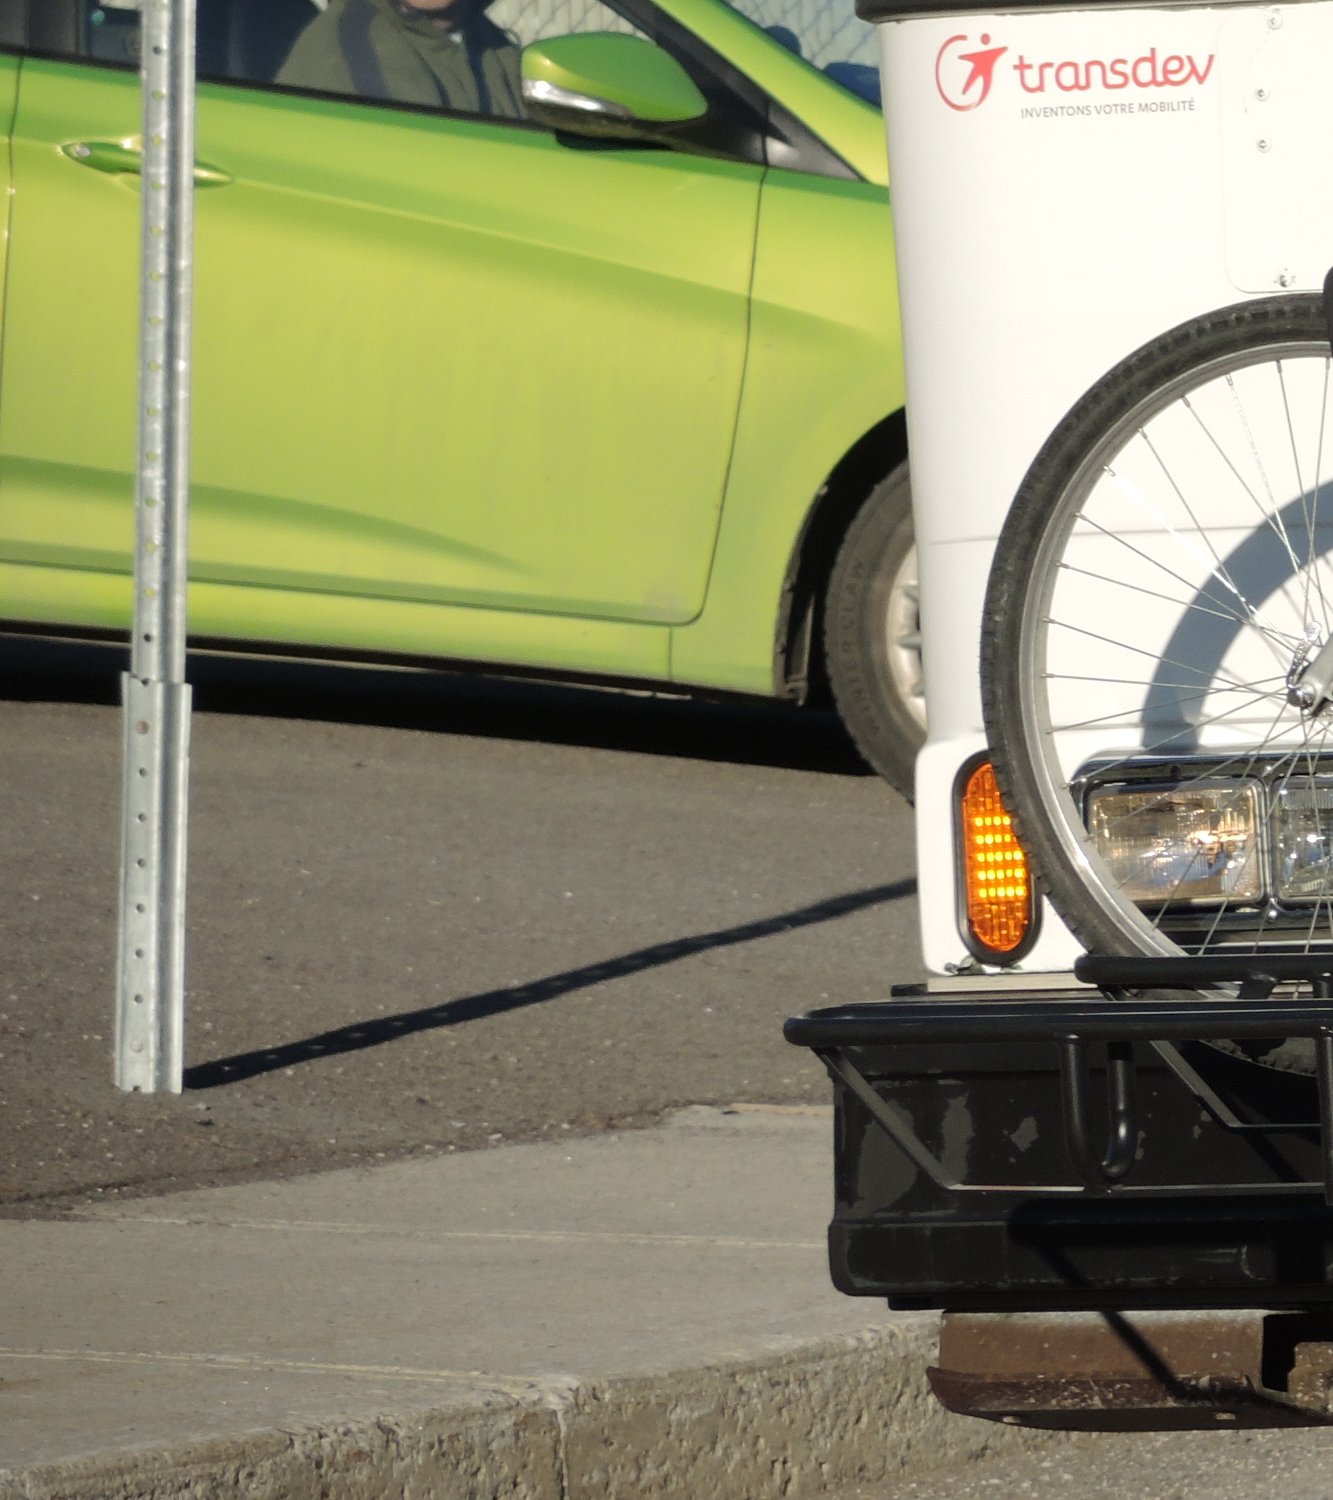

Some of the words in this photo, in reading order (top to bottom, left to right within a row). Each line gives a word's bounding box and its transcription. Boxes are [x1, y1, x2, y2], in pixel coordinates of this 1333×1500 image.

[1012, 46, 1215, 94] transdev
[1020, 103, 1092, 120] INVENTONS
[1094, 101, 1135, 116] VOTRE
[1137, 96, 1196, 114] MOBILITÉ
